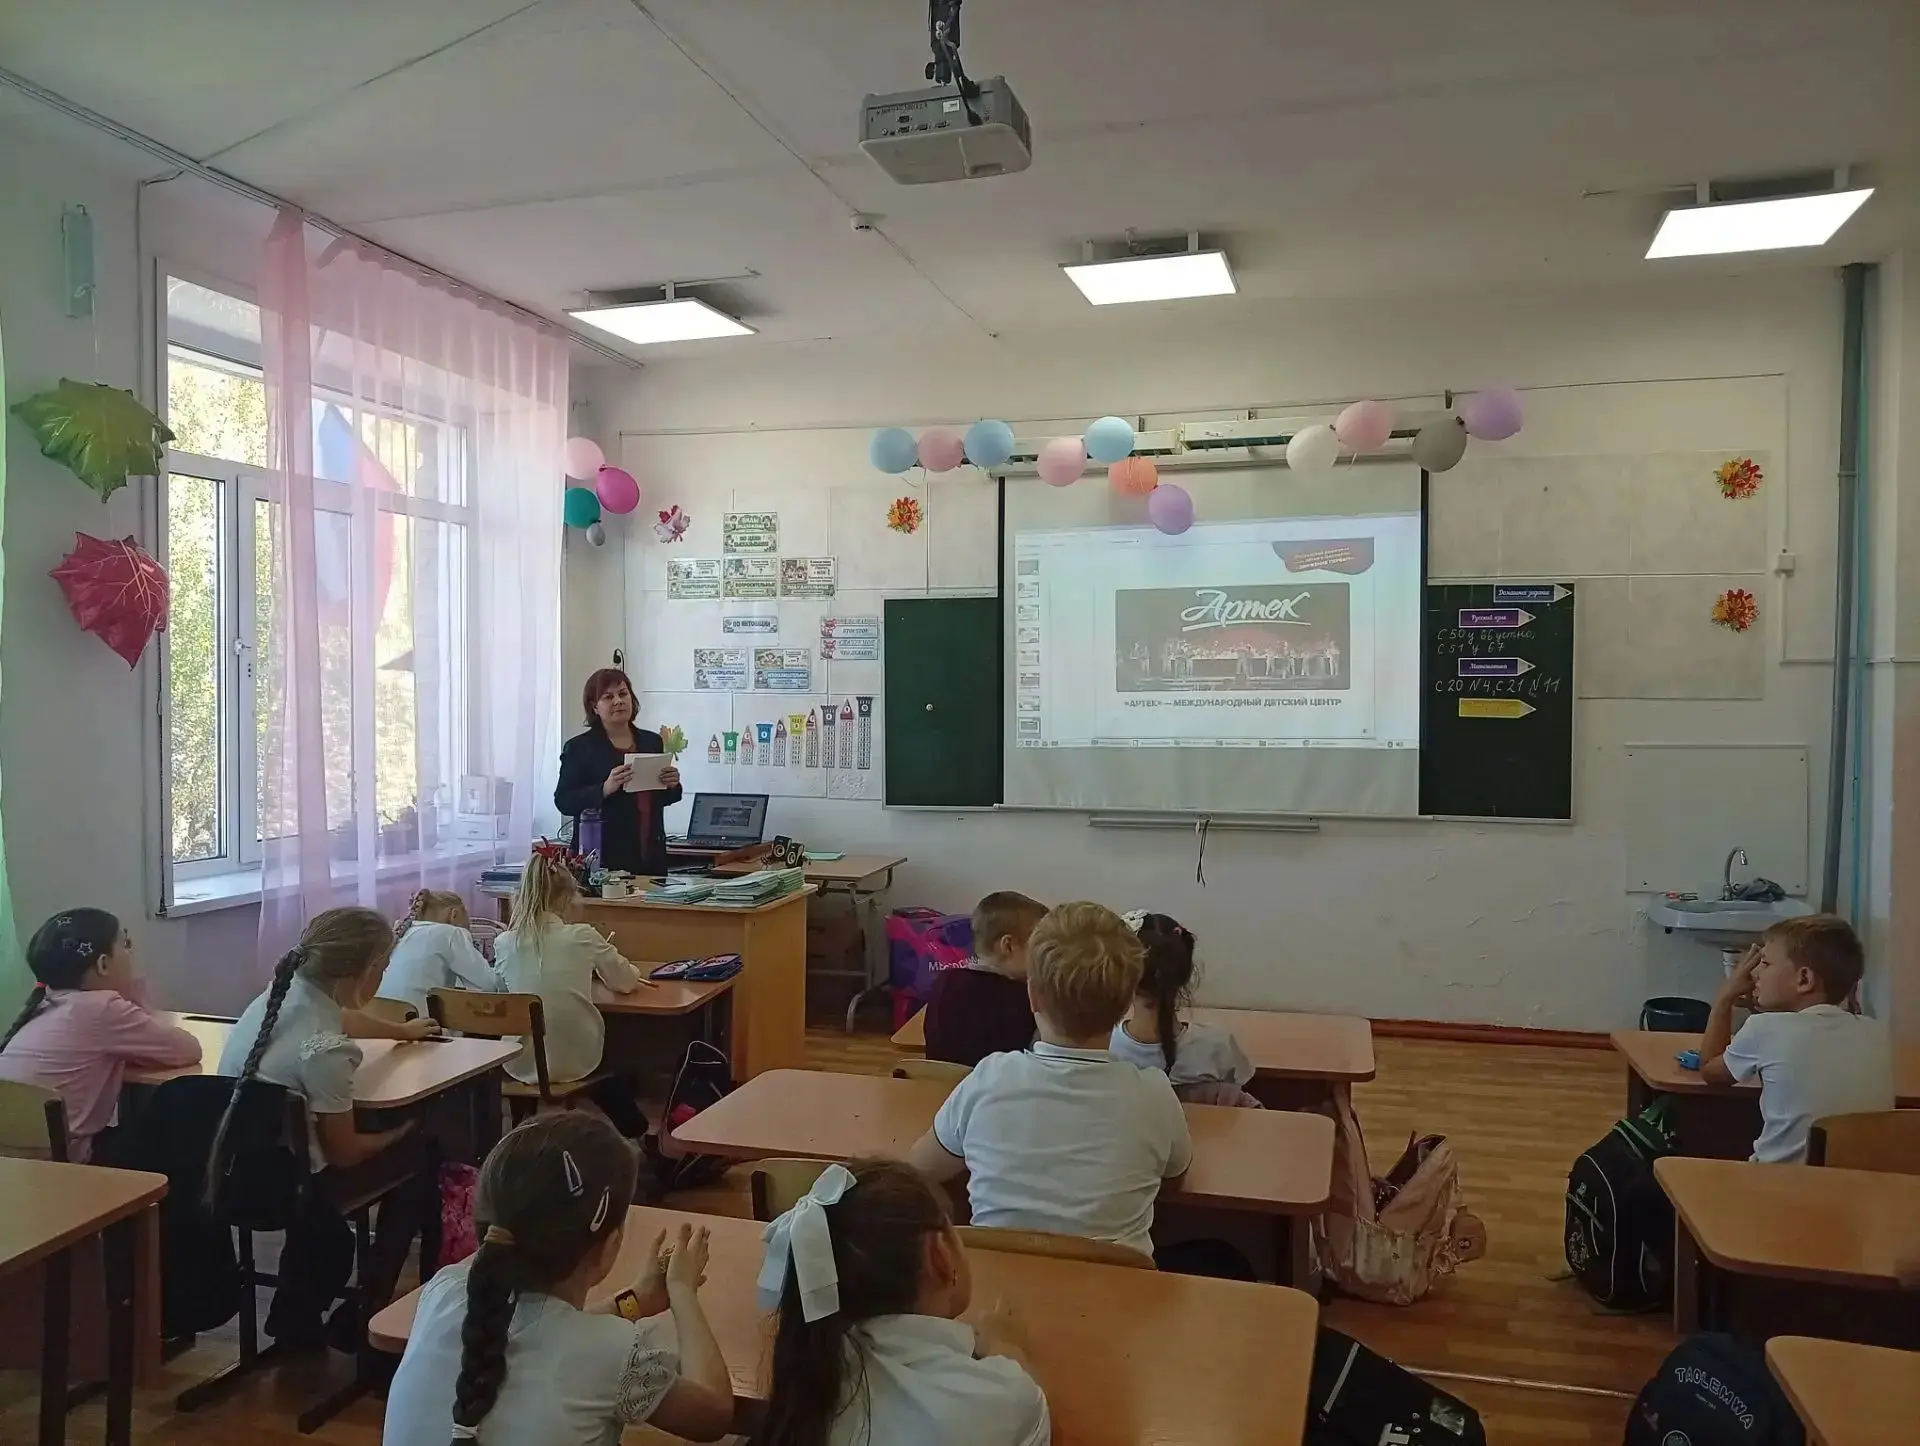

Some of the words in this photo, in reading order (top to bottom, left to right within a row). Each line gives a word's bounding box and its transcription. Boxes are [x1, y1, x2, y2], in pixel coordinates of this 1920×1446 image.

[1180, 589, 1310, 628] Артек
[1450, 629, 1465, 639] 50
[1488, 642, 1504, 653] 67
[1448, 679, 1464, 691] 20
[1506, 679, 1524, 693] 21
[1174, 697, 1262, 707] МЕЖДУНАРОДНЫЙ
[1264, 697, 1308, 707] ДЕТСКИЙ
[1310, 698, 1342, 707] ЦЕНТР
